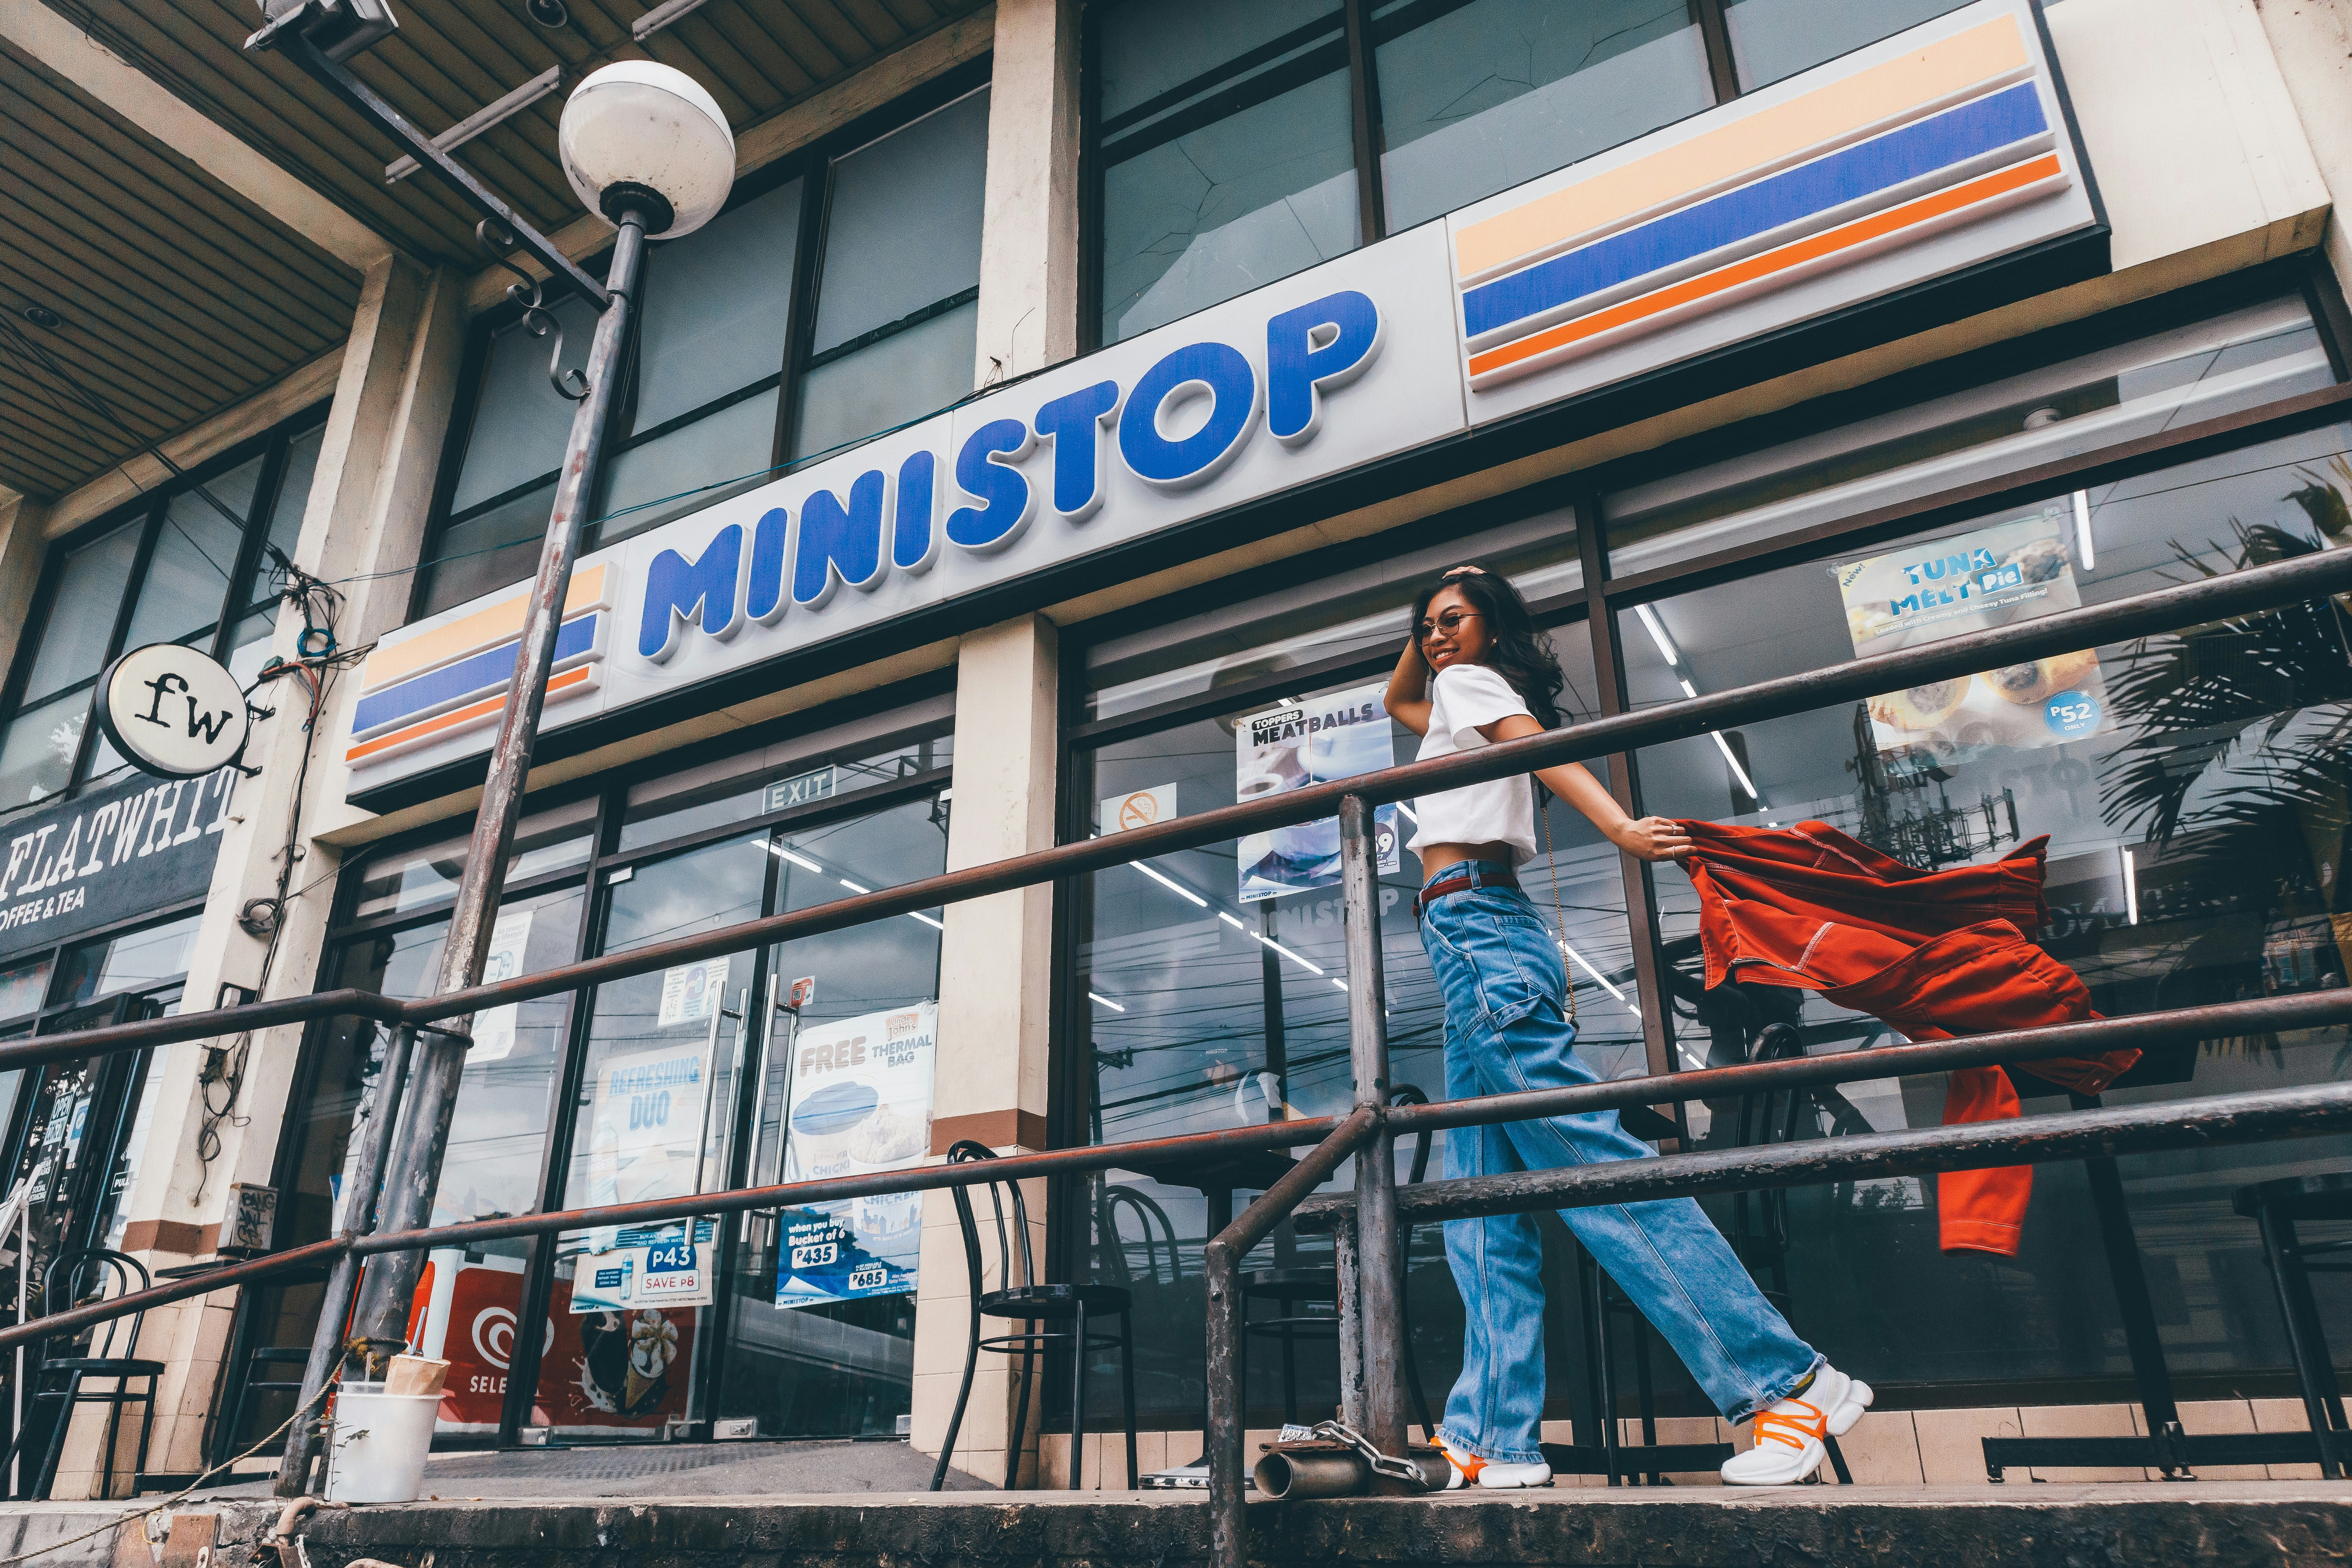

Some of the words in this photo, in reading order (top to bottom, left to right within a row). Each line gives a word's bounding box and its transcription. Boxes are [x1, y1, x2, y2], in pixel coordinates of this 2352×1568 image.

[639, 290, 1380, 660] MINISTOP
[1842, 563, 1866, 588] New!
[1901, 548, 1998, 586] TUNA
[1889, 579, 1971, 617] MELT
[1983, 569, 2016, 591] Pie
[1875, 622, 1903, 635] Loaded
[1905, 617, 1922, 628] with
[1923, 611, 1952, 623] Creamy
[1954, 606, 1969, 615] and
[1969, 600, 1998, 613] Cheesy
[1999, 596, 2019, 606] Tuna
[2020, 588, 2048, 603] Filling!
[135, 673, 232, 744] fw
[1255, 711, 1299, 728] TOPPERS
[1253, 703, 1373, 747] MEATBALLS
[2064, 722, 2086, 731] ONLY
[771, 773, 827, 809] EXIT
[0, 765, 236, 902] FLATWHIT
[1247, 891, 1272, 900] MINISTOP
[0, 899, 44, 932] OFFEE
[43, 897, 55, 919] &
[56, 886, 85, 915] TEA
[506, 922, 526, 932] reward
[887, 1021, 916, 1041] John's
[891, 1015, 911, 1025] Uncle
[800, 1036, 866, 1077] FREE
[872, 1034, 932, 1058] THERMAL
[888, 1052, 915, 1067] BAG
[610, 1056, 700, 1097] REFRESHING
[53, 1094, 73, 1120] OPEN
[630, 1090, 671, 1131] DUO
[114, 1178, 130, 1188] PULL
[788, 1223, 811, 1234] when
[813, 1222, 828, 1233] you
[829, 1218, 845, 1229] buy
[788, 1232, 824, 1247] Bucket
[826, 1229, 837, 1241] of
[838, 1228, 846, 1239] 6
[797, 1246, 832, 1265] P435
[646, 1277, 676, 1289] SAVE
[853, 1272, 882, 1287] P685
[783, 1297, 809, 1306] MINISTOP
